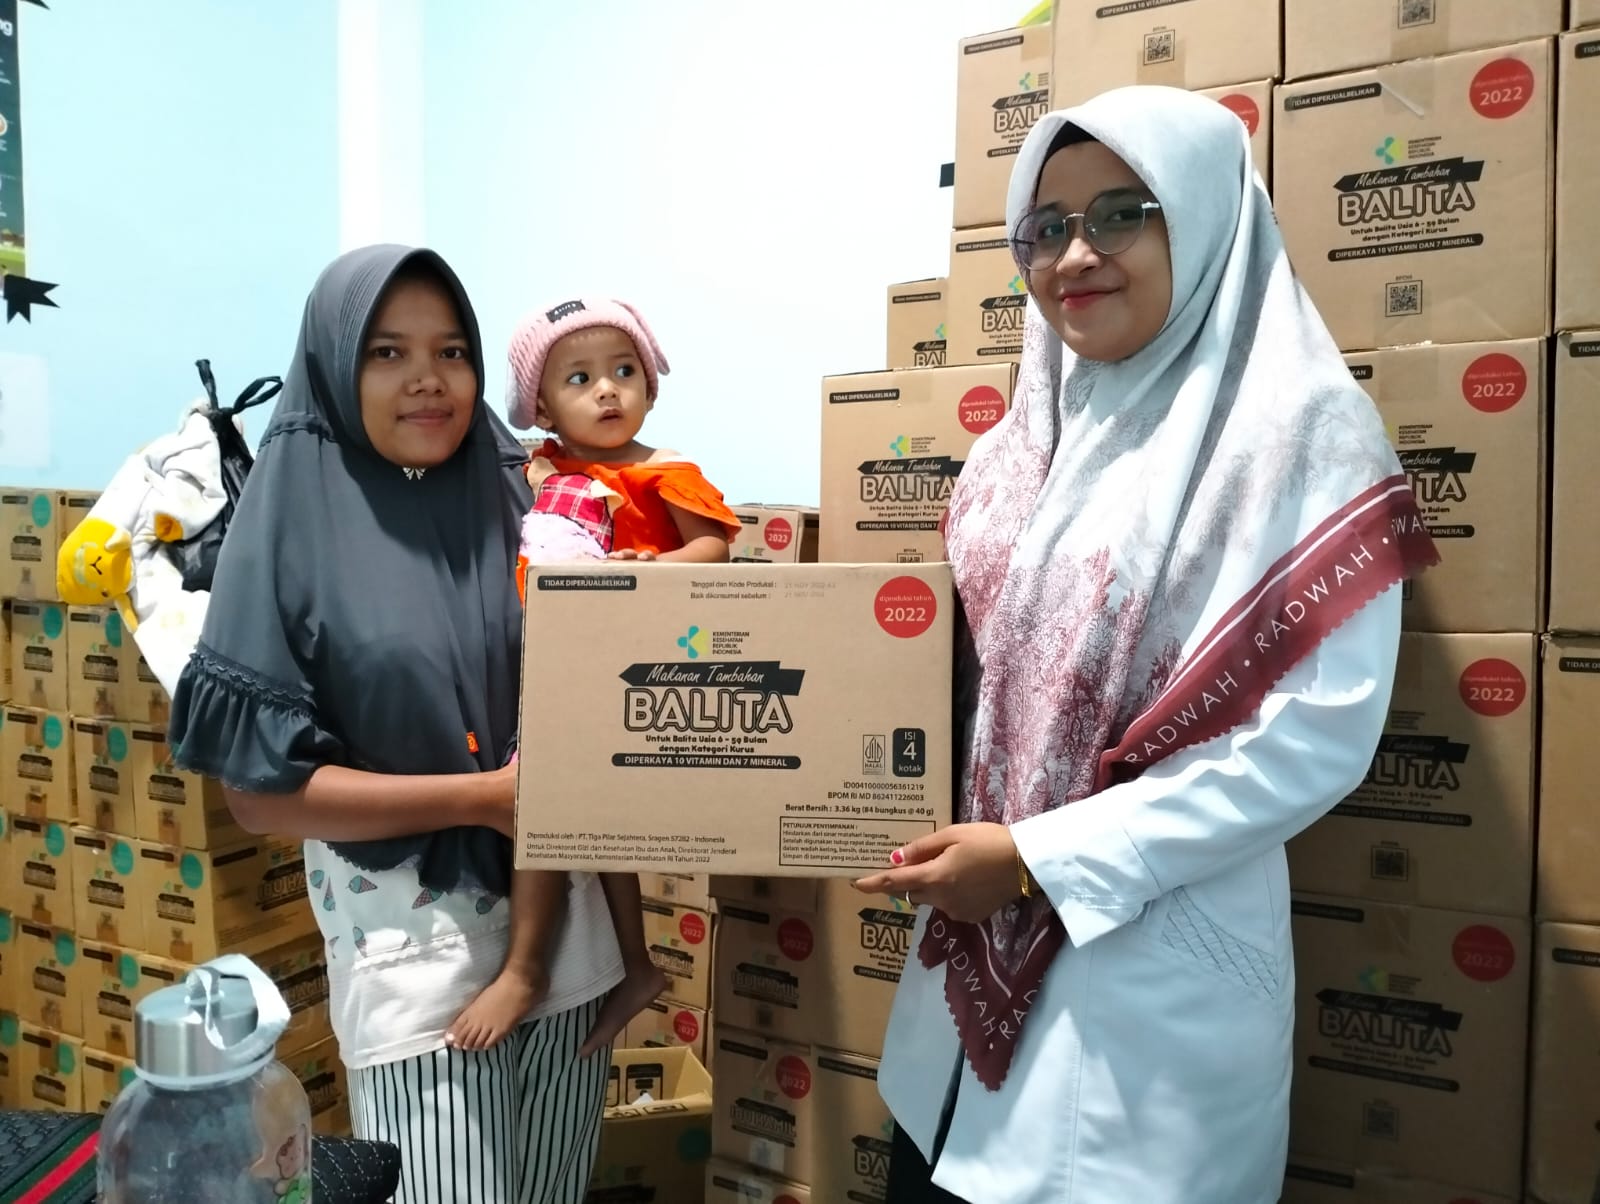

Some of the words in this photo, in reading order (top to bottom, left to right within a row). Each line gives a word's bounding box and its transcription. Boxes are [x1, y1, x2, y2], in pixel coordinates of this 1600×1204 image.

[1479, 86, 1523, 107] 2022
[1354, 171, 1398, 189] Makanan
[1404, 163, 1451, 183] Tambahan
[1337, 180, 1476, 227] BALITA
[1335, 248, 1376, 259] DIPERKAYA
[1387, 244, 1418, 254] VITAMIN
[1419, 241, 1435, 249] DAN
[1441, 237, 1475, 248] MINERAL
[1472, 382, 1516, 398] 2022
[965, 409, 998, 423] 2022
[860, 474, 956, 503] BALITA
[544, 579, 565, 587] TIDAK
[565, 579, 631, 587] DIPERJUALBELIKAN
[690, 581, 715, 589] Tanggal
[705, 591, 740, 599] dikonsumsi
[741, 591, 767, 599] sebelum
[879, 594, 912, 604] diproduksi
[912, 593, 932, 602] tahun
[1254, 544, 1374, 654] RADWAH
[884, 607, 927, 622] 2022
[646, 664, 701, 683] Makanan
[706, 664, 766, 684] Tambahan
[1469, 686, 1516, 702] 2022
[624, 687, 794, 734] BALITA
[1124, 670, 1238, 764] RADWAH
[645, 735, 671, 743] Untuk
[672, 735, 697, 743] Balita
[698, 735, 717, 743] Usia
[718, 735, 723, 743] 6
[731, 736, 742, 745] 59
[743, 736, 768, 744] Bulan
[904, 731, 916, 740] ISI
[658, 744, 690, 754] dengan
[691, 744, 729, 755] Kategori
[730, 745, 755, 754] Kurus
[902, 741, 918, 761] 4
[624, 755, 673, 765] DIPERKAYA
[674, 756, 685, 765] 10
[685, 756, 722, 766] VITAMIN
[722, 757, 742, 766] DAN
[743, 757, 749, 766] 7
[750, 757, 788, 767] MINERAL
[898, 763, 922, 773] kotak
[827, 791, 850, 800] BPOM
[859, 792, 871, 800] MD
[785, 803, 805, 811] Berat
[805, 803, 829, 811] Bersih
[834, 804, 851, 812] 3.36
[851, 805, 861, 814] kg
[861, 805, 874, 814] (84
[874, 805, 907, 815] bungkus
[915, 807, 925, 815] 40
[926, 807, 935, 817] g)
[527, 832, 560, 840] Diproduksi
[682, 927, 703, 938] 2022
[1462, 950, 1504, 969] 2022
[1318, 1005, 1453, 1059] BALITA
